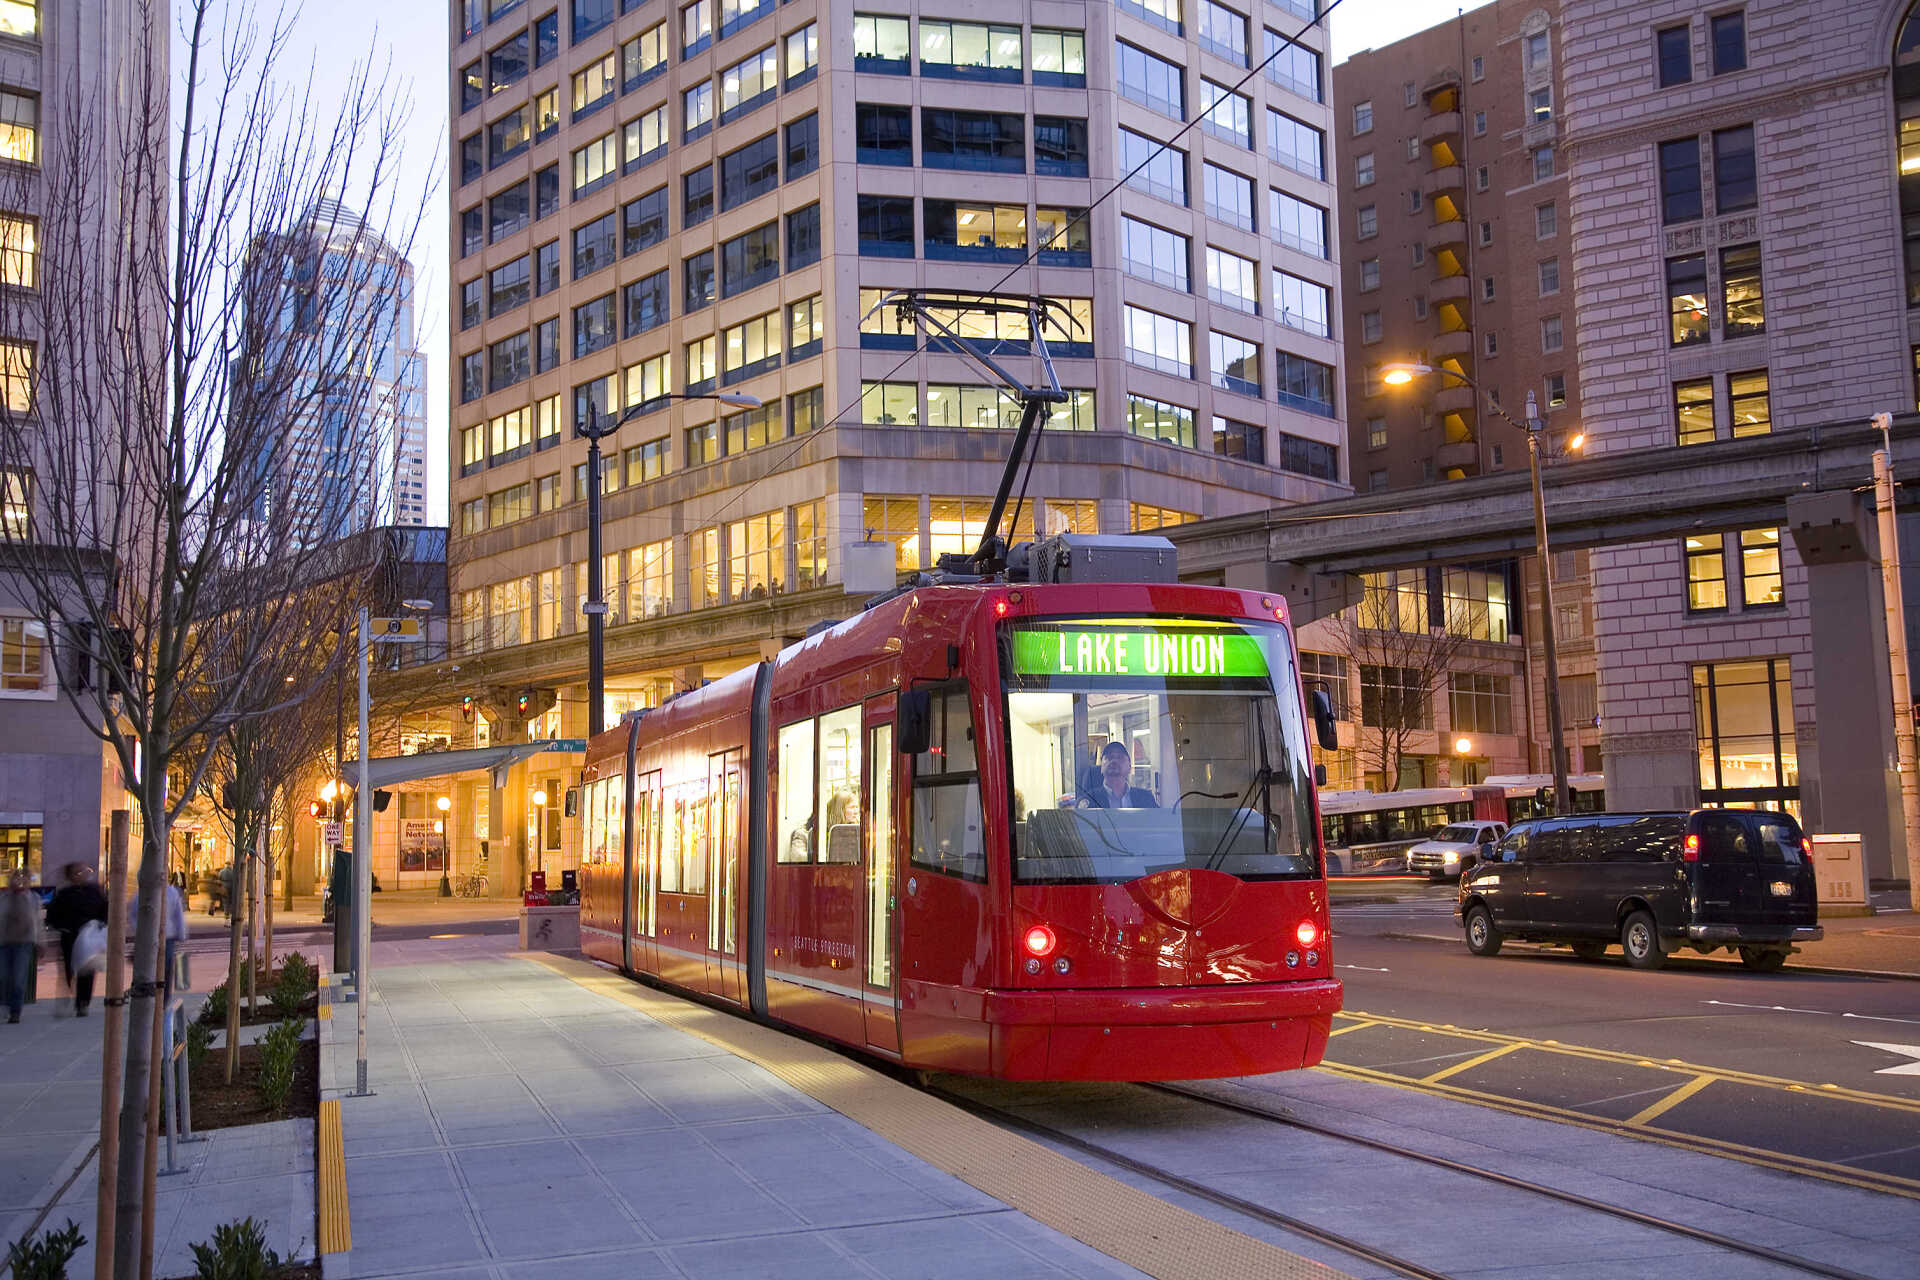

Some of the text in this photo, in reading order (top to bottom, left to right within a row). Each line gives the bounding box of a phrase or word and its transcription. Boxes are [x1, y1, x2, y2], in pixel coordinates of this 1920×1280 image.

[1059, 632, 1225, 674] LAKE UNION
[563, 743, 574, 752] Wy
[794, 935, 857, 960] SEATTLE STREETCAR
